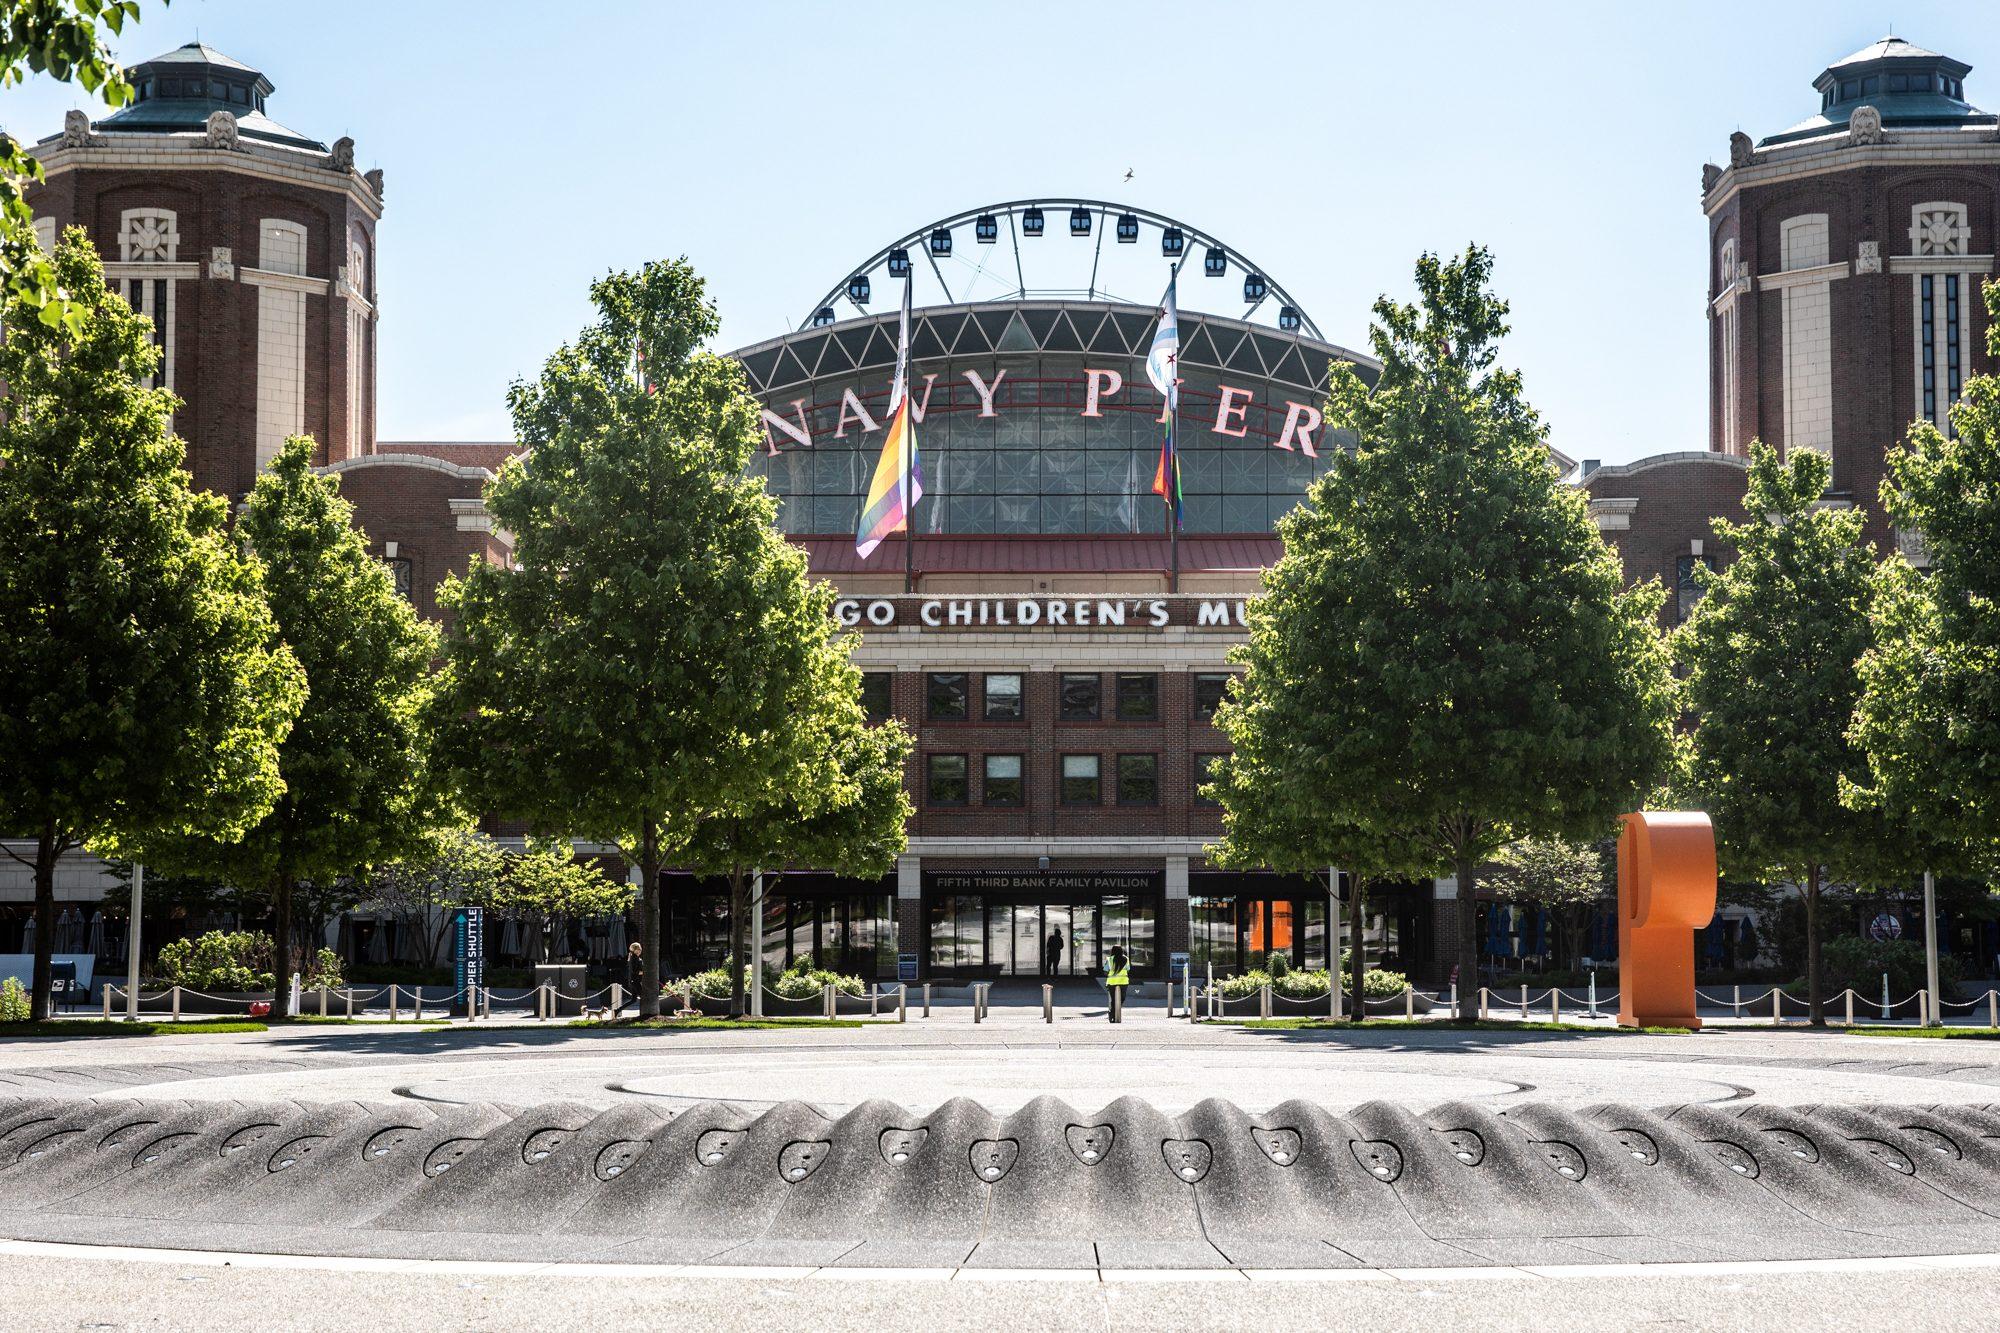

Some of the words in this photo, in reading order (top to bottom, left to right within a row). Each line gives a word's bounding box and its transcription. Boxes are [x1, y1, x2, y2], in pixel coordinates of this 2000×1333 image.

[920, 599, 1170, 628] CHILDREN'S
[936, 877, 971, 888] FIFTH
[973, 877, 1010, 888] THIRD
[1012, 877, 1046, 888] BANK
[1049, 877, 1091, 888] FAMILY
[1094, 877, 1149, 888] PAVILION
[467, 909, 478, 958] SHUTTLE
[467, 960, 477, 985] PIER
